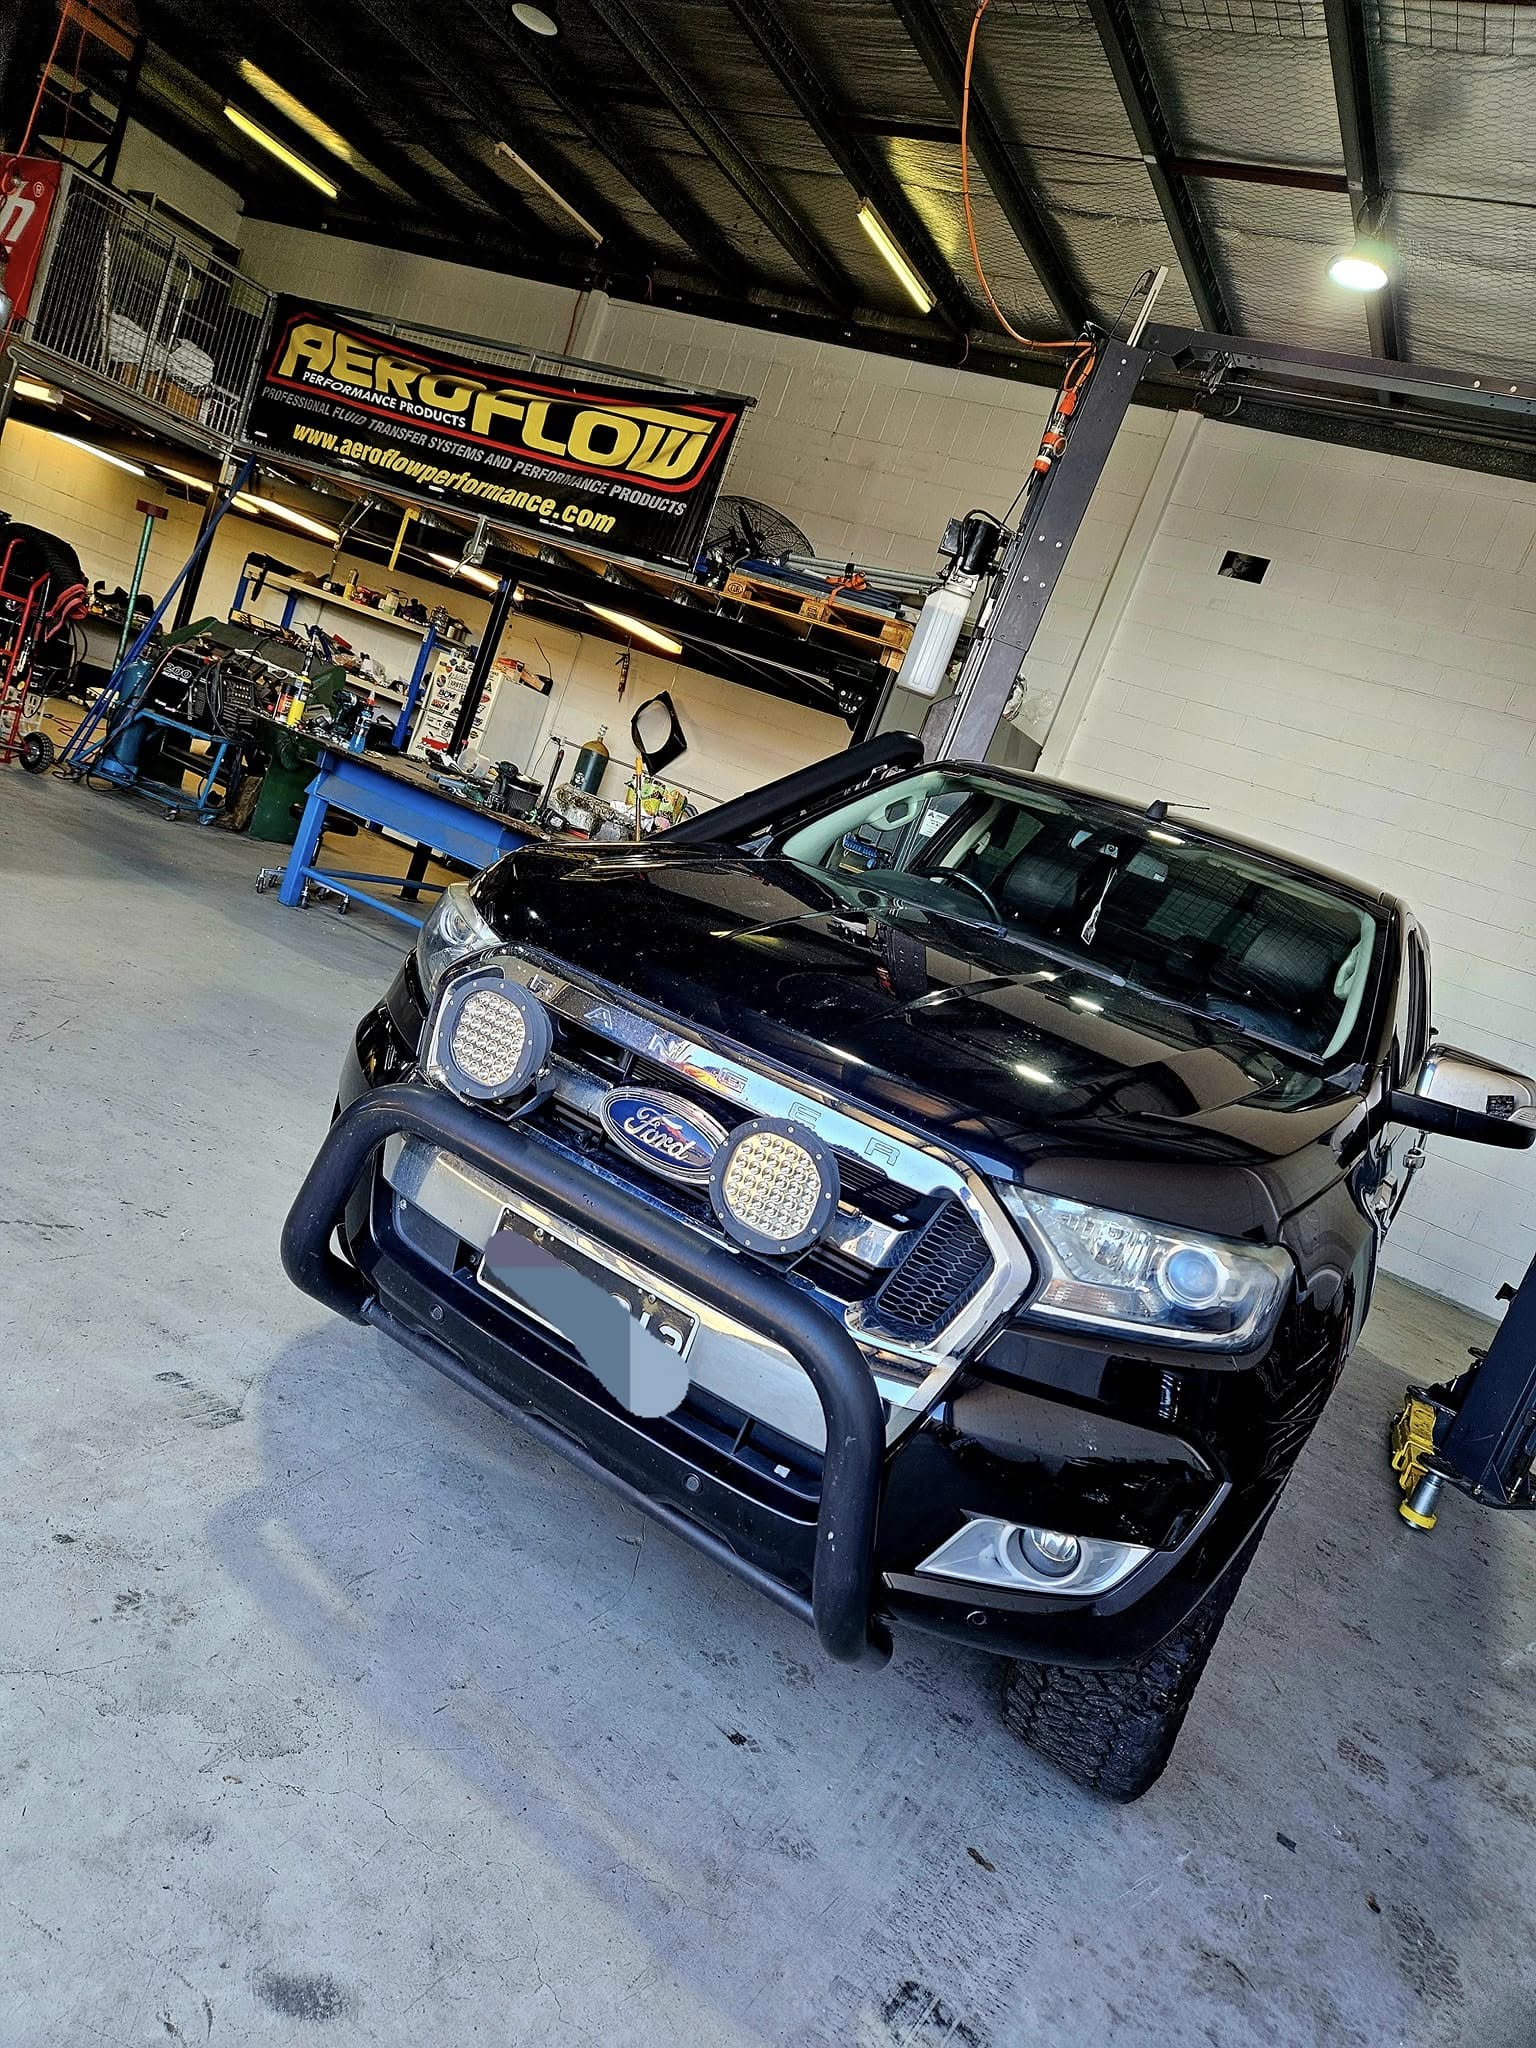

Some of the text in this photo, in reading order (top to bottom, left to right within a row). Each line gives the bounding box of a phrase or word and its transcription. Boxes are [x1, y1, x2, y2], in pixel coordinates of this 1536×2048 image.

[261, 386, 688, 516] PROFESSIONAL FLUID TRANSFER SYSTEMS AND PERFORMANCE PRODUCTS
[278, 322, 717, 479] AEROFLOW
[302, 371, 467, 429] PERFORMANCE PRODUCTS
[292, 423, 617, 534] www.aeroflowperformance.com
[526, 973, 901, 1167] RANGER
[623, 1106, 697, 1160] Ford
